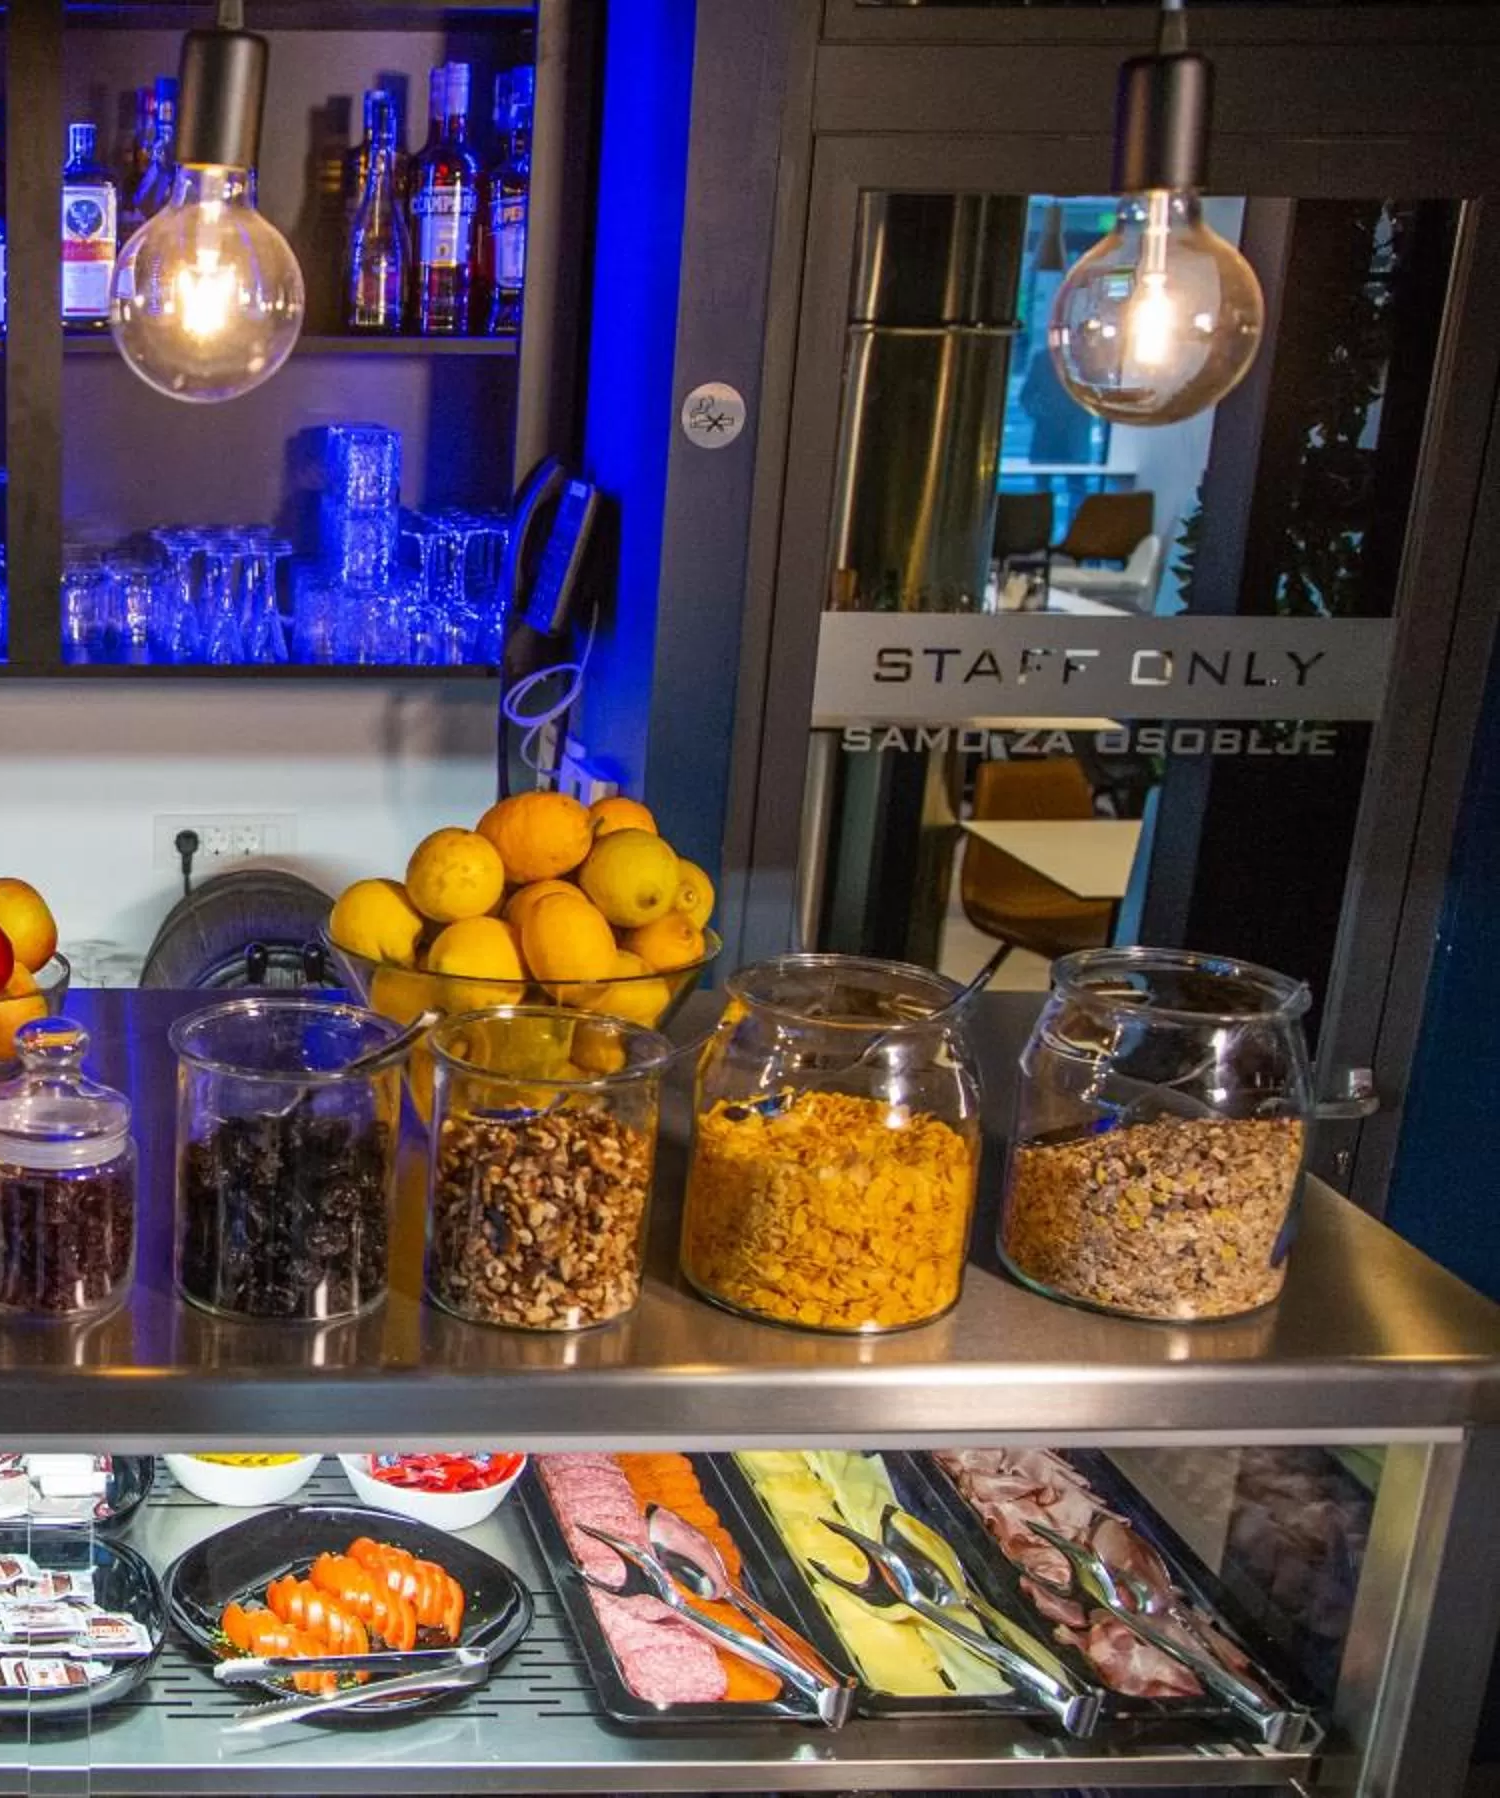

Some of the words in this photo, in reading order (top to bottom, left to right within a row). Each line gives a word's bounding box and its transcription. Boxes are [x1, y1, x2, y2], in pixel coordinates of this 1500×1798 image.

[873, 648, 1100, 684] STAFF
[1130, 649, 1329, 685] ONLY
[841, 726, 990, 752] SAMO
[1012, 727, 1074, 753] ZA
[1097, 728, 1338, 756] OSOBLJE
